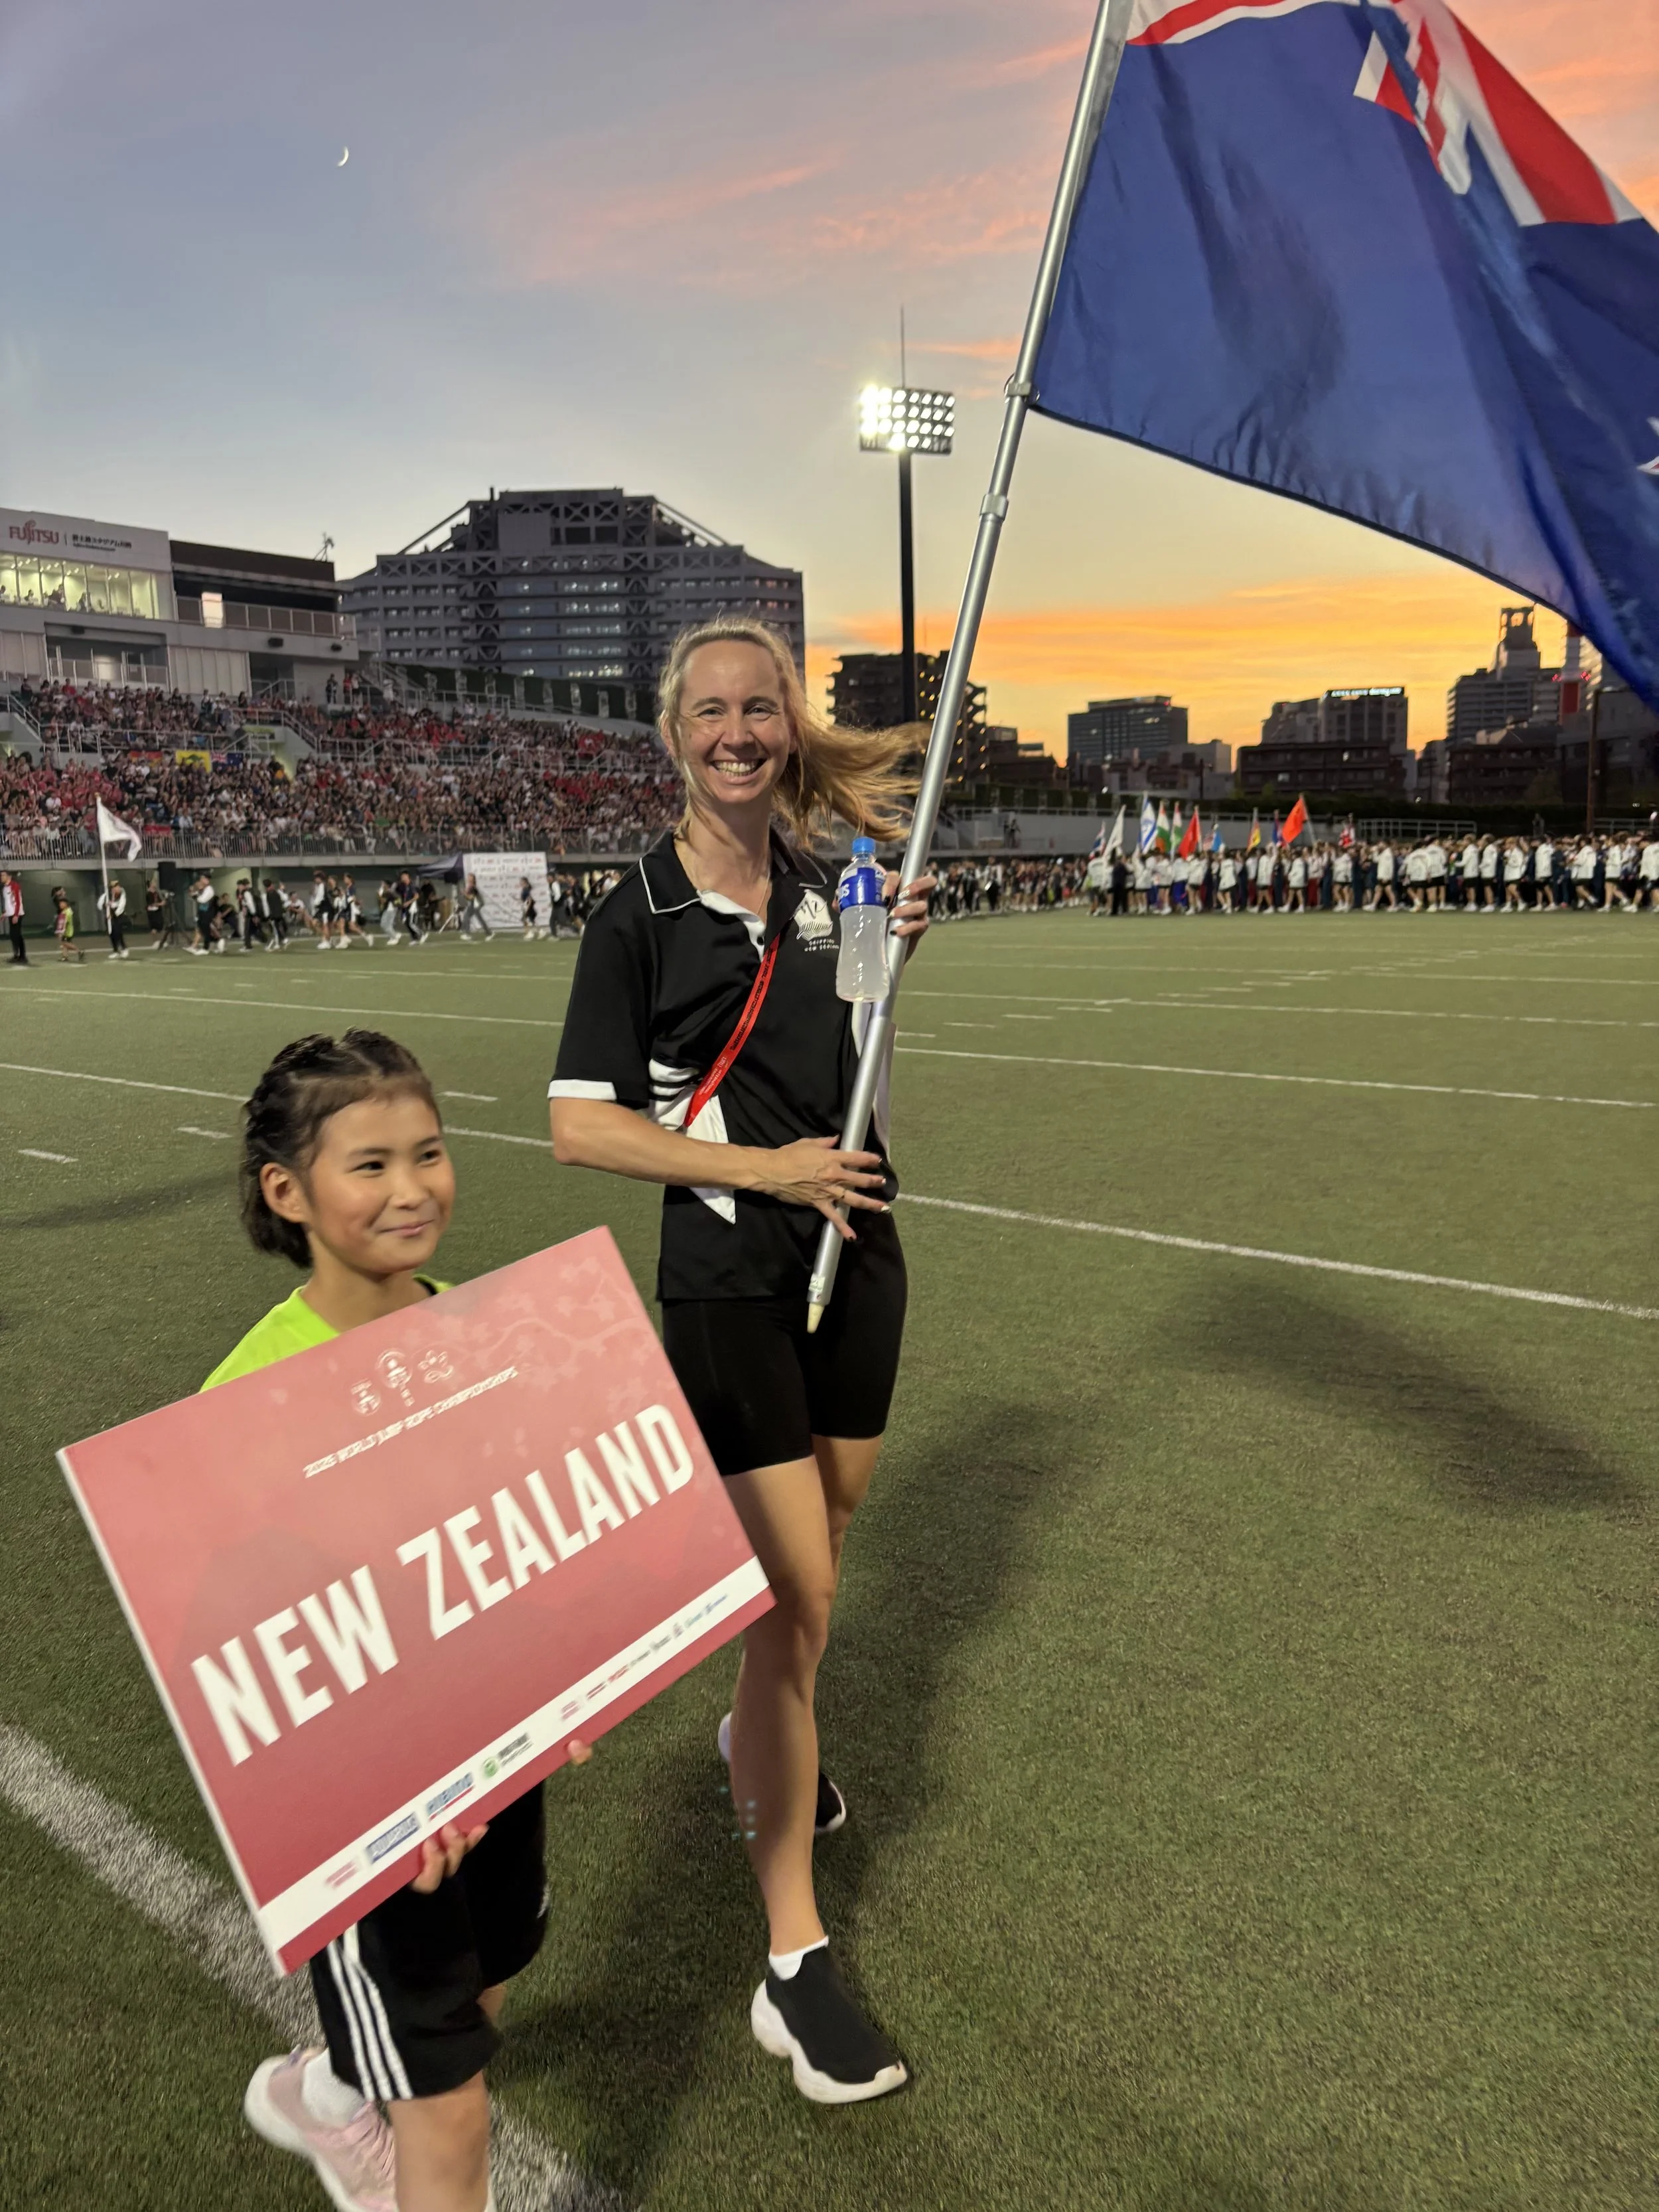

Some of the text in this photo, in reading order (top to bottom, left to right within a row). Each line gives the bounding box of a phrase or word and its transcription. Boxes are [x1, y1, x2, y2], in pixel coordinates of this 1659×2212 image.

[9, 520, 60, 545] FUJITSU
[191, 1404, 695, 1767] NEW ZEALAND
